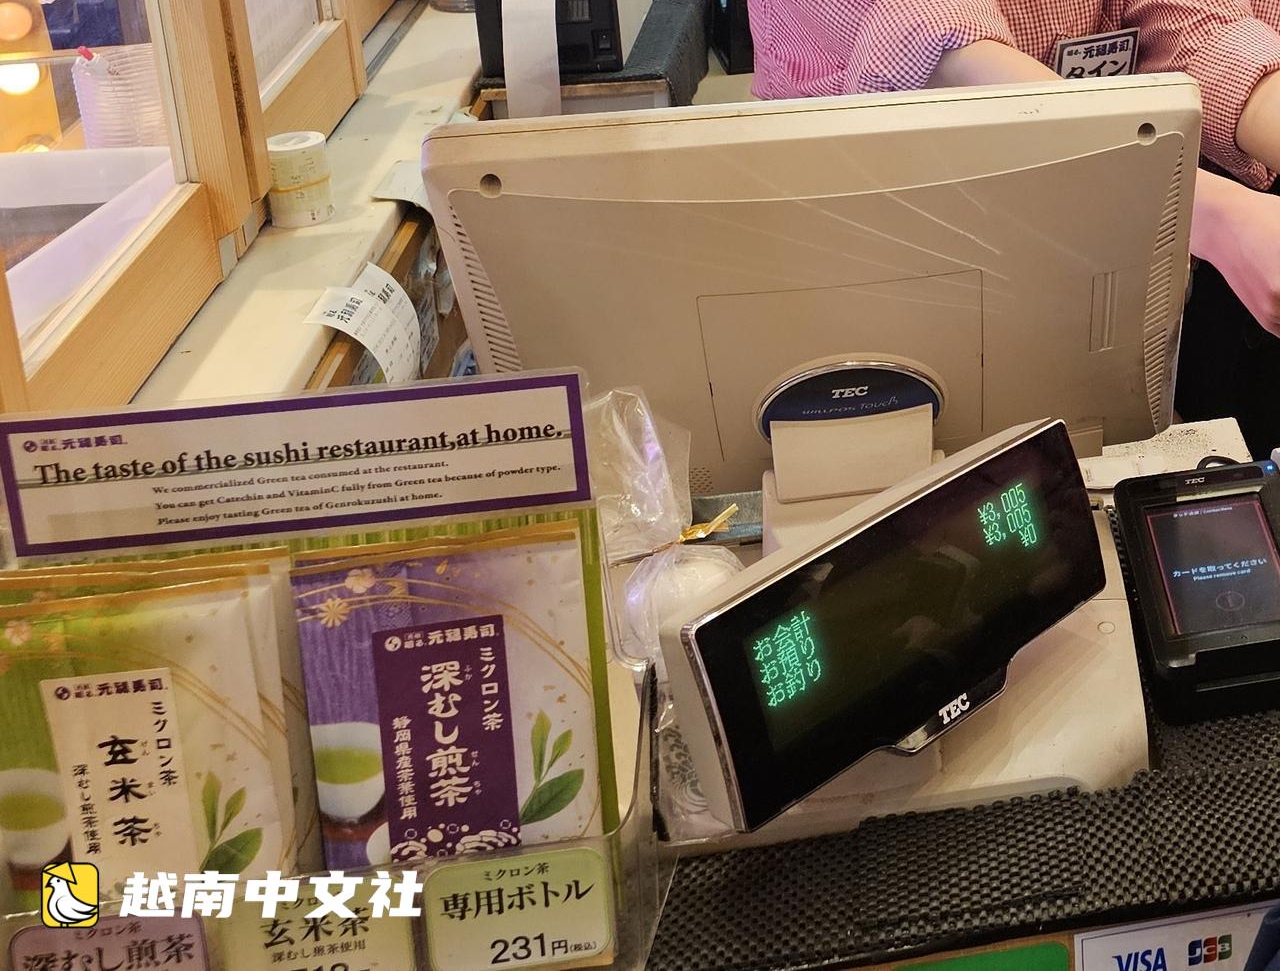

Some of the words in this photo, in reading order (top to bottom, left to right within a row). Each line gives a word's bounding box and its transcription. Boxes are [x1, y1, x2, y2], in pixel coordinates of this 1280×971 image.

[831, 386, 869, 400] TEC
[34, 462, 86, 485] The
[92, 457, 156, 481] taste
[161, 452, 189, 475] of
[194, 449, 237, 472] the
[243, 441, 311, 467] sushi
[485, 422, 563, 442] home.
[152, 486, 169, 494] We
[171, 478, 255, 493] commercialized
[256, 475, 288, 485] Green
[308, 468, 360, 480] consumed
[374, 465, 391, 474] the
[393, 461, 449, 472] restaurant.
[154, 501, 176, 510] You
[177, 500, 196, 508] can
[198, 499, 215, 509] get
[216, 494, 264, 504] Catechin
[266, 490, 286, 499] and
[288, 485, 339, 497] VitaminC
[341, 482, 366, 493] fully
[367, 480, 392, 490] from
[394, 477, 425, 487] Green
[427, 476, 443, 484] tea
[444, 472, 483, 482] because
[485, 469, 497, 478] of
[497, 466, 535, 479] powder
[536, 464, 561, 474] type.
[1184, 476, 1206, 485] TEC
[157, 517, 190, 526] Please
[193, 513, 221, 524] enjoy
[222, 510, 260, 519] tasting
[261, 507, 293, 516] Green
[295, 504, 311, 512] tea
[312, 502, 324, 510] of
[325, 494, 398, 509] Genrokuzushi
[399, 494, 409, 502] at
[411, 492, 442, 501] home.
[977, 482, 1026, 525] ¥3,005
[983, 503, 1032, 546] ¥3,005
[1018, 523, 1037, 547] ¥0
[1172, 557, 1268, 579] カードを取ってください
[1193, 572, 1212, 582] Please
[1213, 569, 1235, 579] remove
[1236, 567, 1251, 576] card
[753, 610, 811, 661] お会計
[759, 636, 815, 684] お預り
[479, 646, 504, 731] ミクロン茶
[766, 658, 821, 707] お釣り
[938, 692, 970, 725] TEC
[151, 701, 179, 786] ミクロン茶
[420, 660, 473, 807] 深むし煎茶
[392, 715, 418, 820] 静岡県産茶葉使用
[72, 764, 102, 855] 深むし煎茶使用
[97, 735, 153, 846] 玄米茶
[484, 862, 550, 881] ミクロン茶
[439, 879, 595, 921] 専用ボトル
[74, 920, 144, 940] ミクロン茶
[271, 939, 367, 965] 深むし煎茶使用
[1112, 947, 1167, 971] VISA
[1188, 934, 1233, 966] JCB
